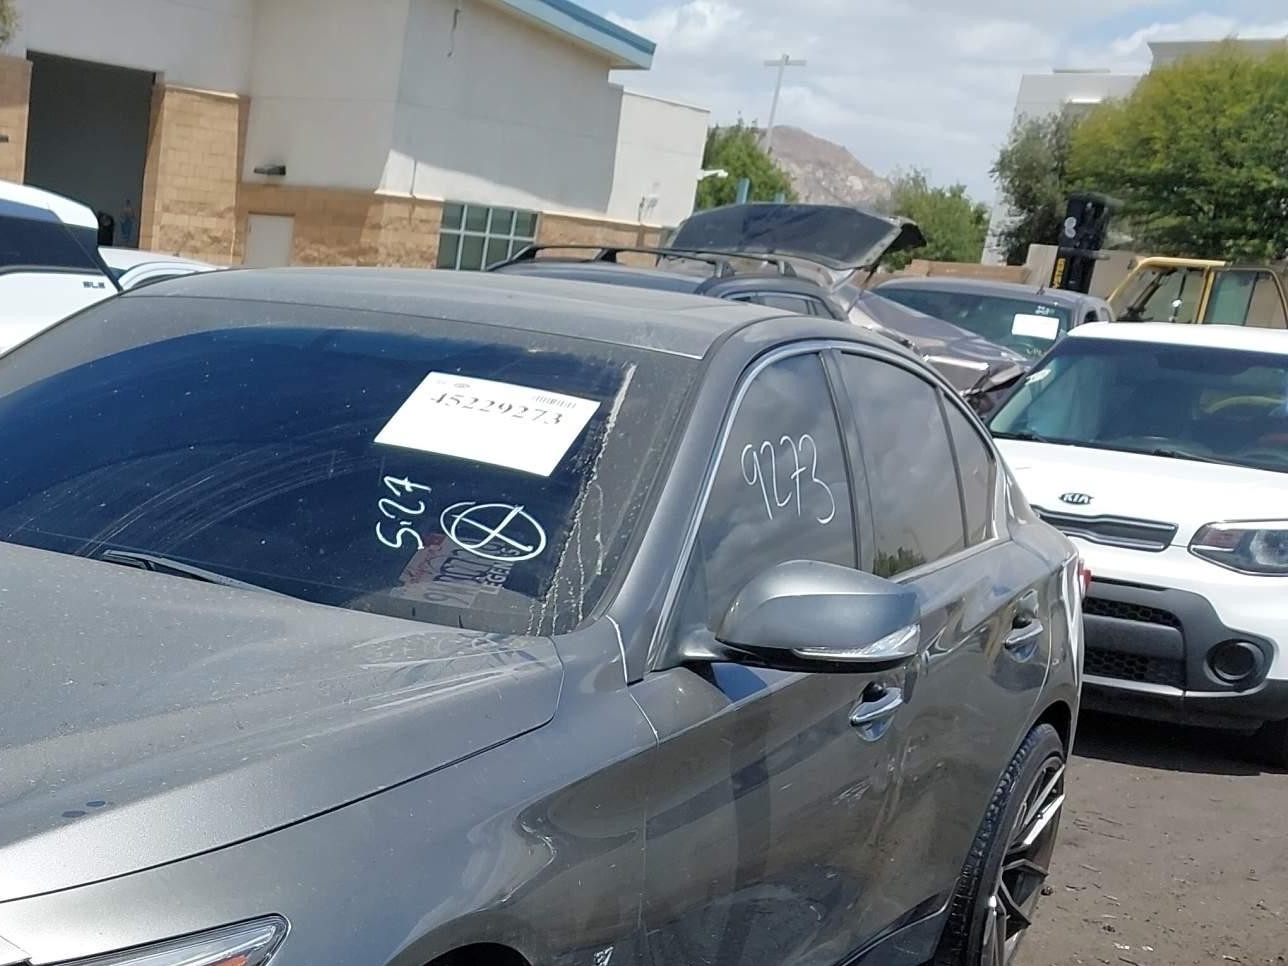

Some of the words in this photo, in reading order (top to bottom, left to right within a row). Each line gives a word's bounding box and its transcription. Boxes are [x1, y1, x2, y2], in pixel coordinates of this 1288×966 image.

[430, 393, 564, 426] 45229273
[741, 434, 836, 524] 9273
[1062, 493, 1091, 505] KIA
[483, 545, 522, 596] LEGENS
